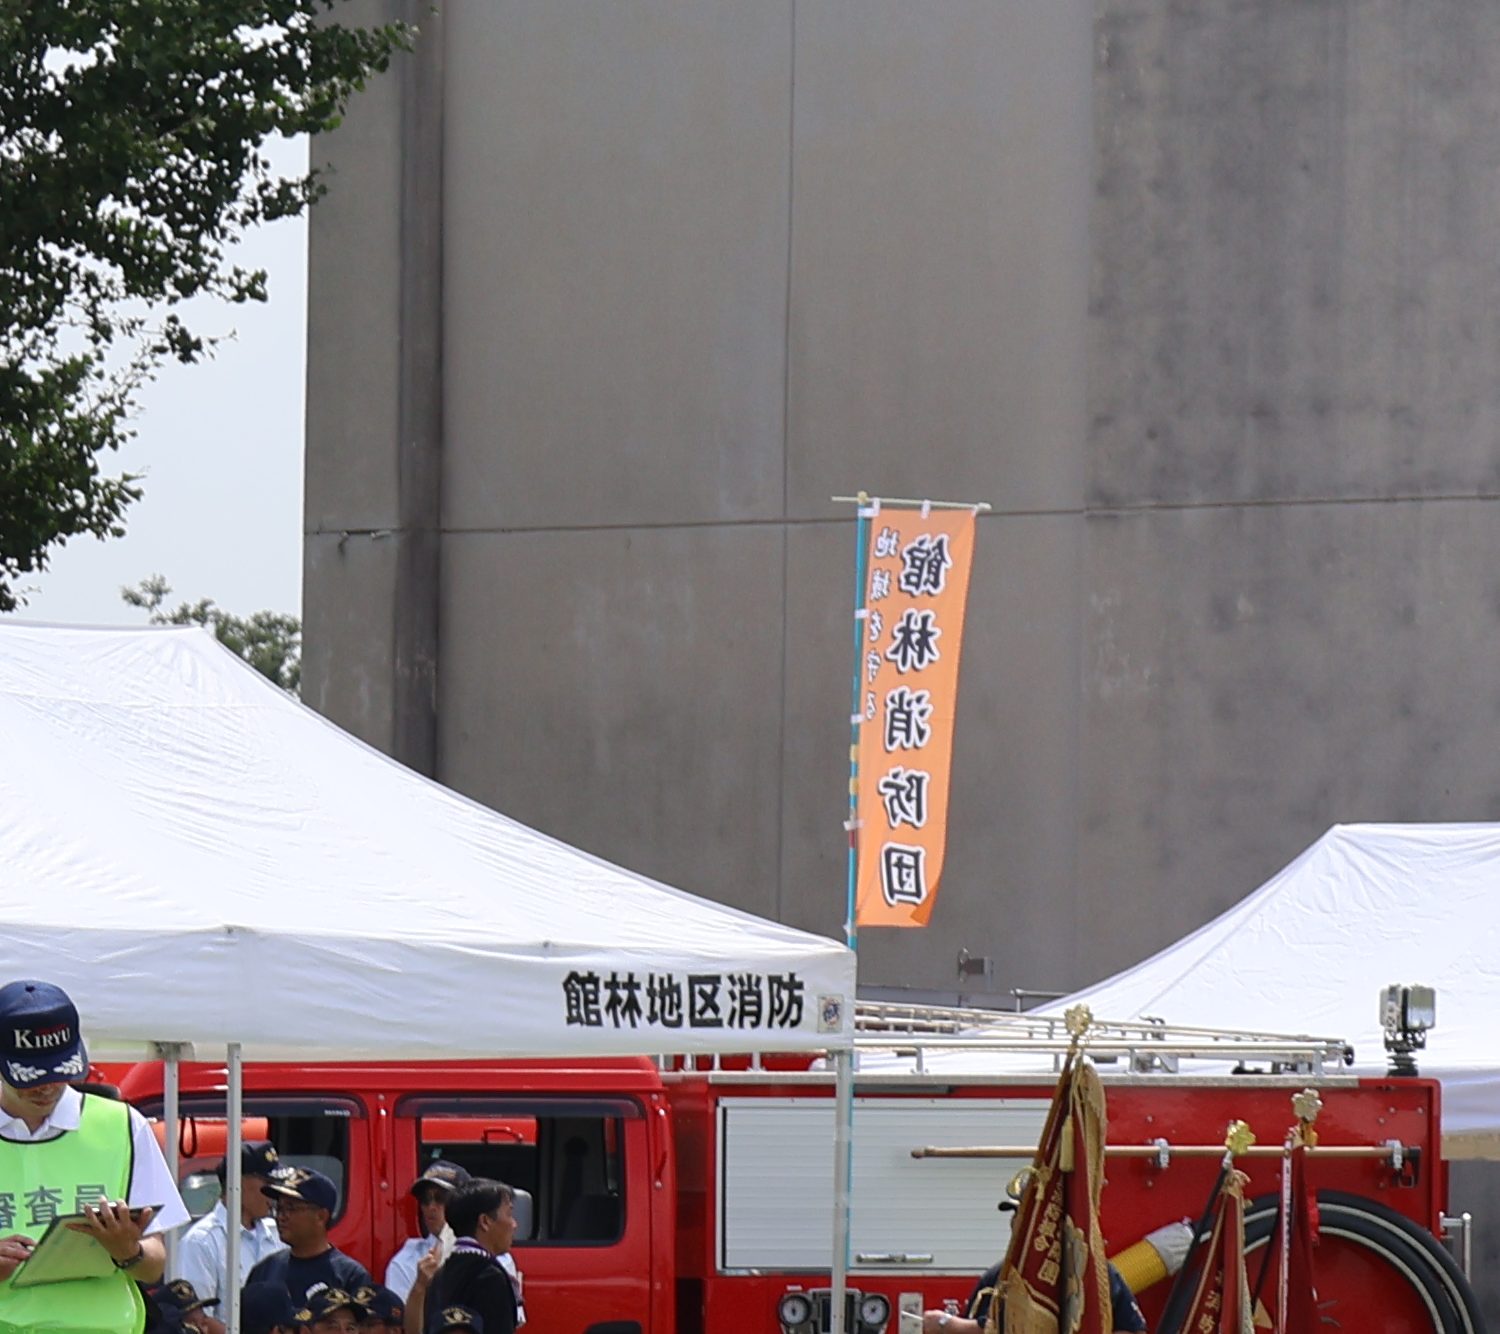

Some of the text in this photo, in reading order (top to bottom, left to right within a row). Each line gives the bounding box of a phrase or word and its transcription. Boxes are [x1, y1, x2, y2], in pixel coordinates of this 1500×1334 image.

[562, 970, 805, 1028] 館林地区消防
[14, 1026, 72, 1049] KIRYU
